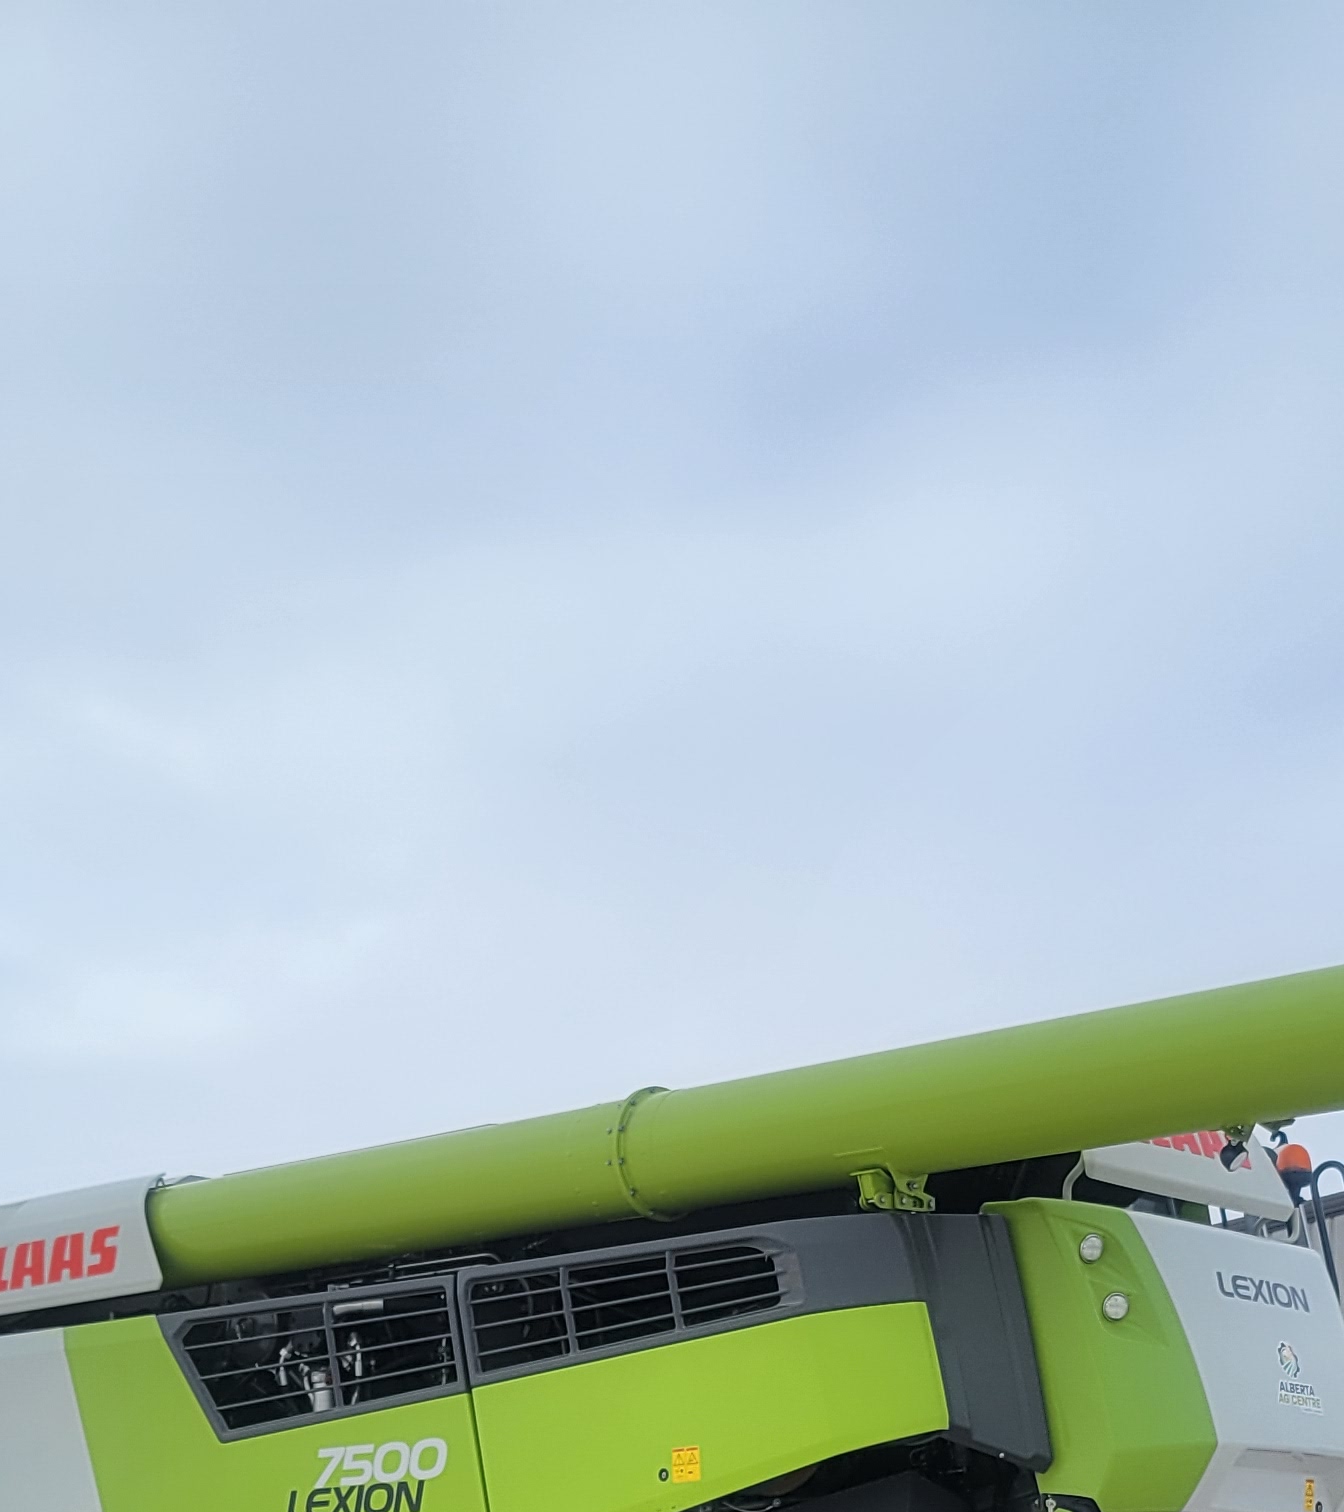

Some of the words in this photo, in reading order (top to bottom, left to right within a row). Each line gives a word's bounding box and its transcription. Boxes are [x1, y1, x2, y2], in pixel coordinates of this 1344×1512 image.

[1215, 1271, 1311, 1313] LEXION
[1279, 1381, 1316, 1396] ALBERTA
[313, 1437, 448, 1490] 7500
